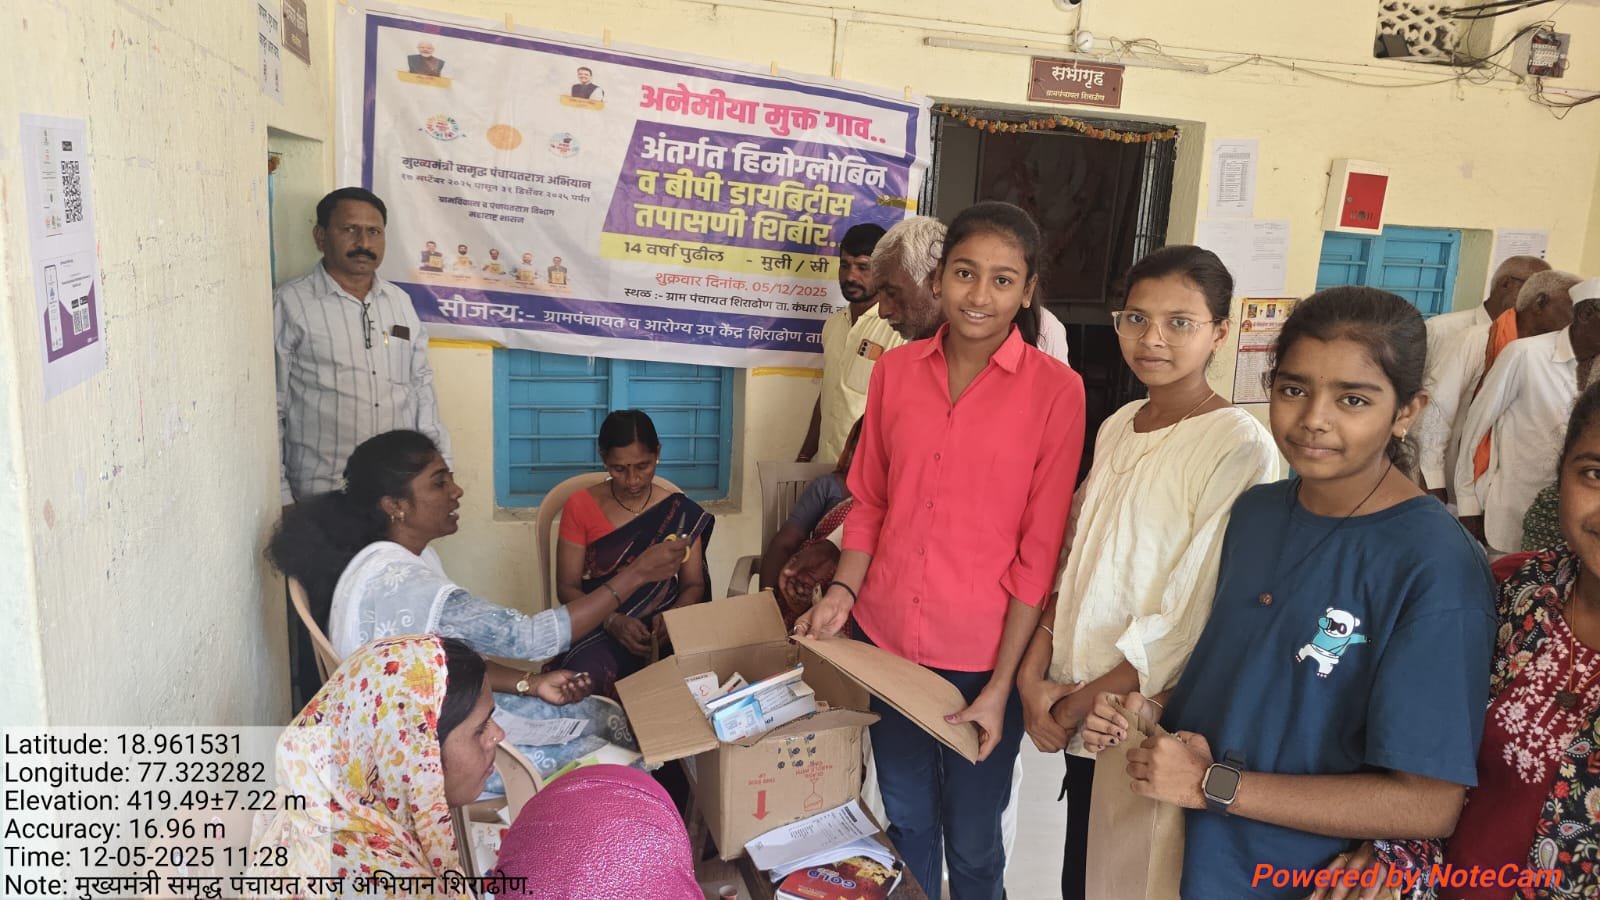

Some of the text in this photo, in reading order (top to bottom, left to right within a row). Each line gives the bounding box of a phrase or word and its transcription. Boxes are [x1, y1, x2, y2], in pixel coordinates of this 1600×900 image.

[1052, 65, 1105, 88] सभागृह
[640, 82, 887, 144] अनेमीया मुक्त गाव..
[401, 156, 453, 173] मुख्यमंत्री
[456, 163, 488, 179] समृद्ध
[547, 173, 592, 190] अभियान
[641, 131, 888, 188] अंतर्गत हिमोग्लोबिन
[636, 167, 855, 218] व बीपी डायबिटीस
[634, 202, 749, 238] तपासणी
[624, 241, 642, 253] 14
[646, 242, 678, 258] वर्षा
[681, 246, 724, 263] पुढील
[761, 254, 792, 271] मुली
[624, 288, 652, 298] स्थळ
[666, 292, 688, 302] ग्राम
[689, 293, 728, 306] पंचायत
[730, 296, 772, 310] शिराढोण
[775, 301, 789, 311] ता.
[792, 302, 817, 313] कंधार
[820, 302, 833, 314] जि.
[656, 272, 703, 287] शुक्रवार
[752, 281, 828, 297] 05/12/2025
[543, 309, 626, 329] ग्रामपंचायत
[628, 318, 641, 330] व
[644, 318, 694, 334] आरोग्य
[696, 324, 717, 336] उप
[719, 322, 744, 339] केंद्र
[747, 325, 803, 342] शिराढोण
